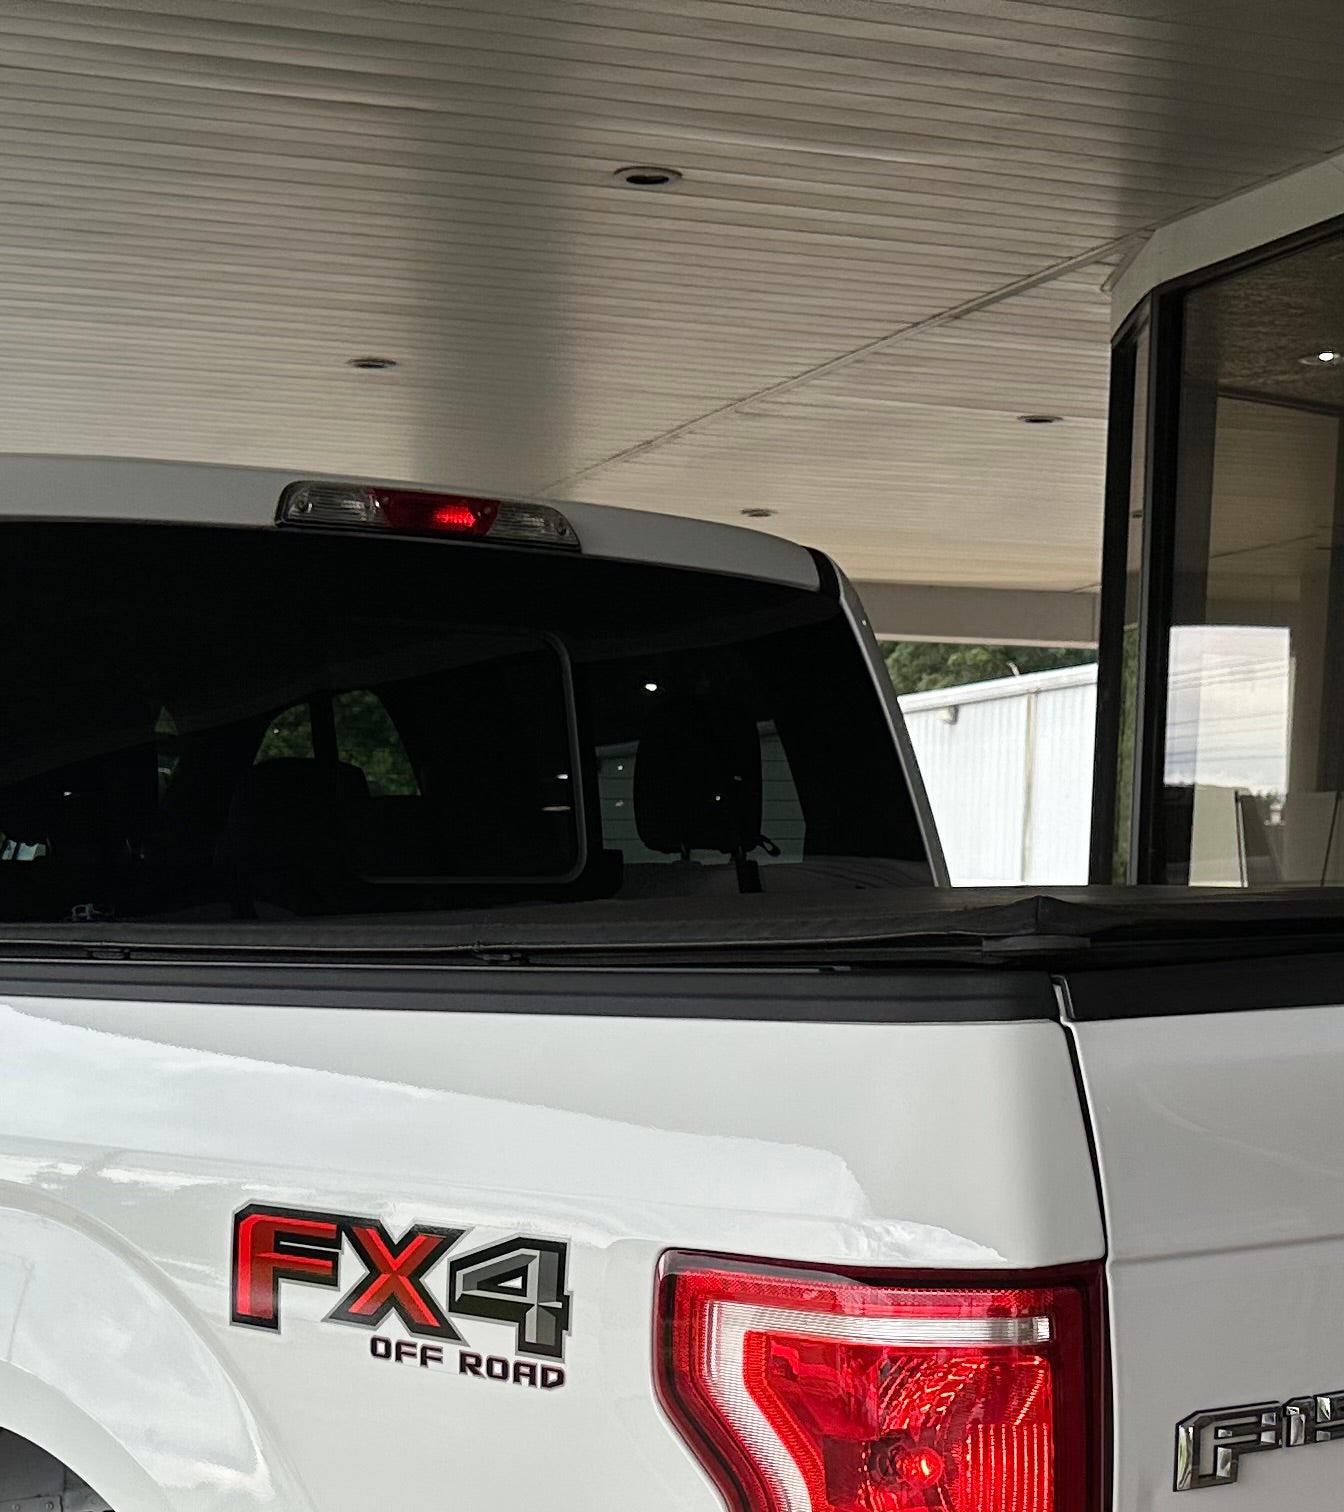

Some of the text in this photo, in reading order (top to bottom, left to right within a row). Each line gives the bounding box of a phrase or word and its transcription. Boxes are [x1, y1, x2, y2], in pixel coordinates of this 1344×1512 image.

[230, 1200, 573, 1362] FX4
[370, 1335, 566, 1390] OFF ROAD
